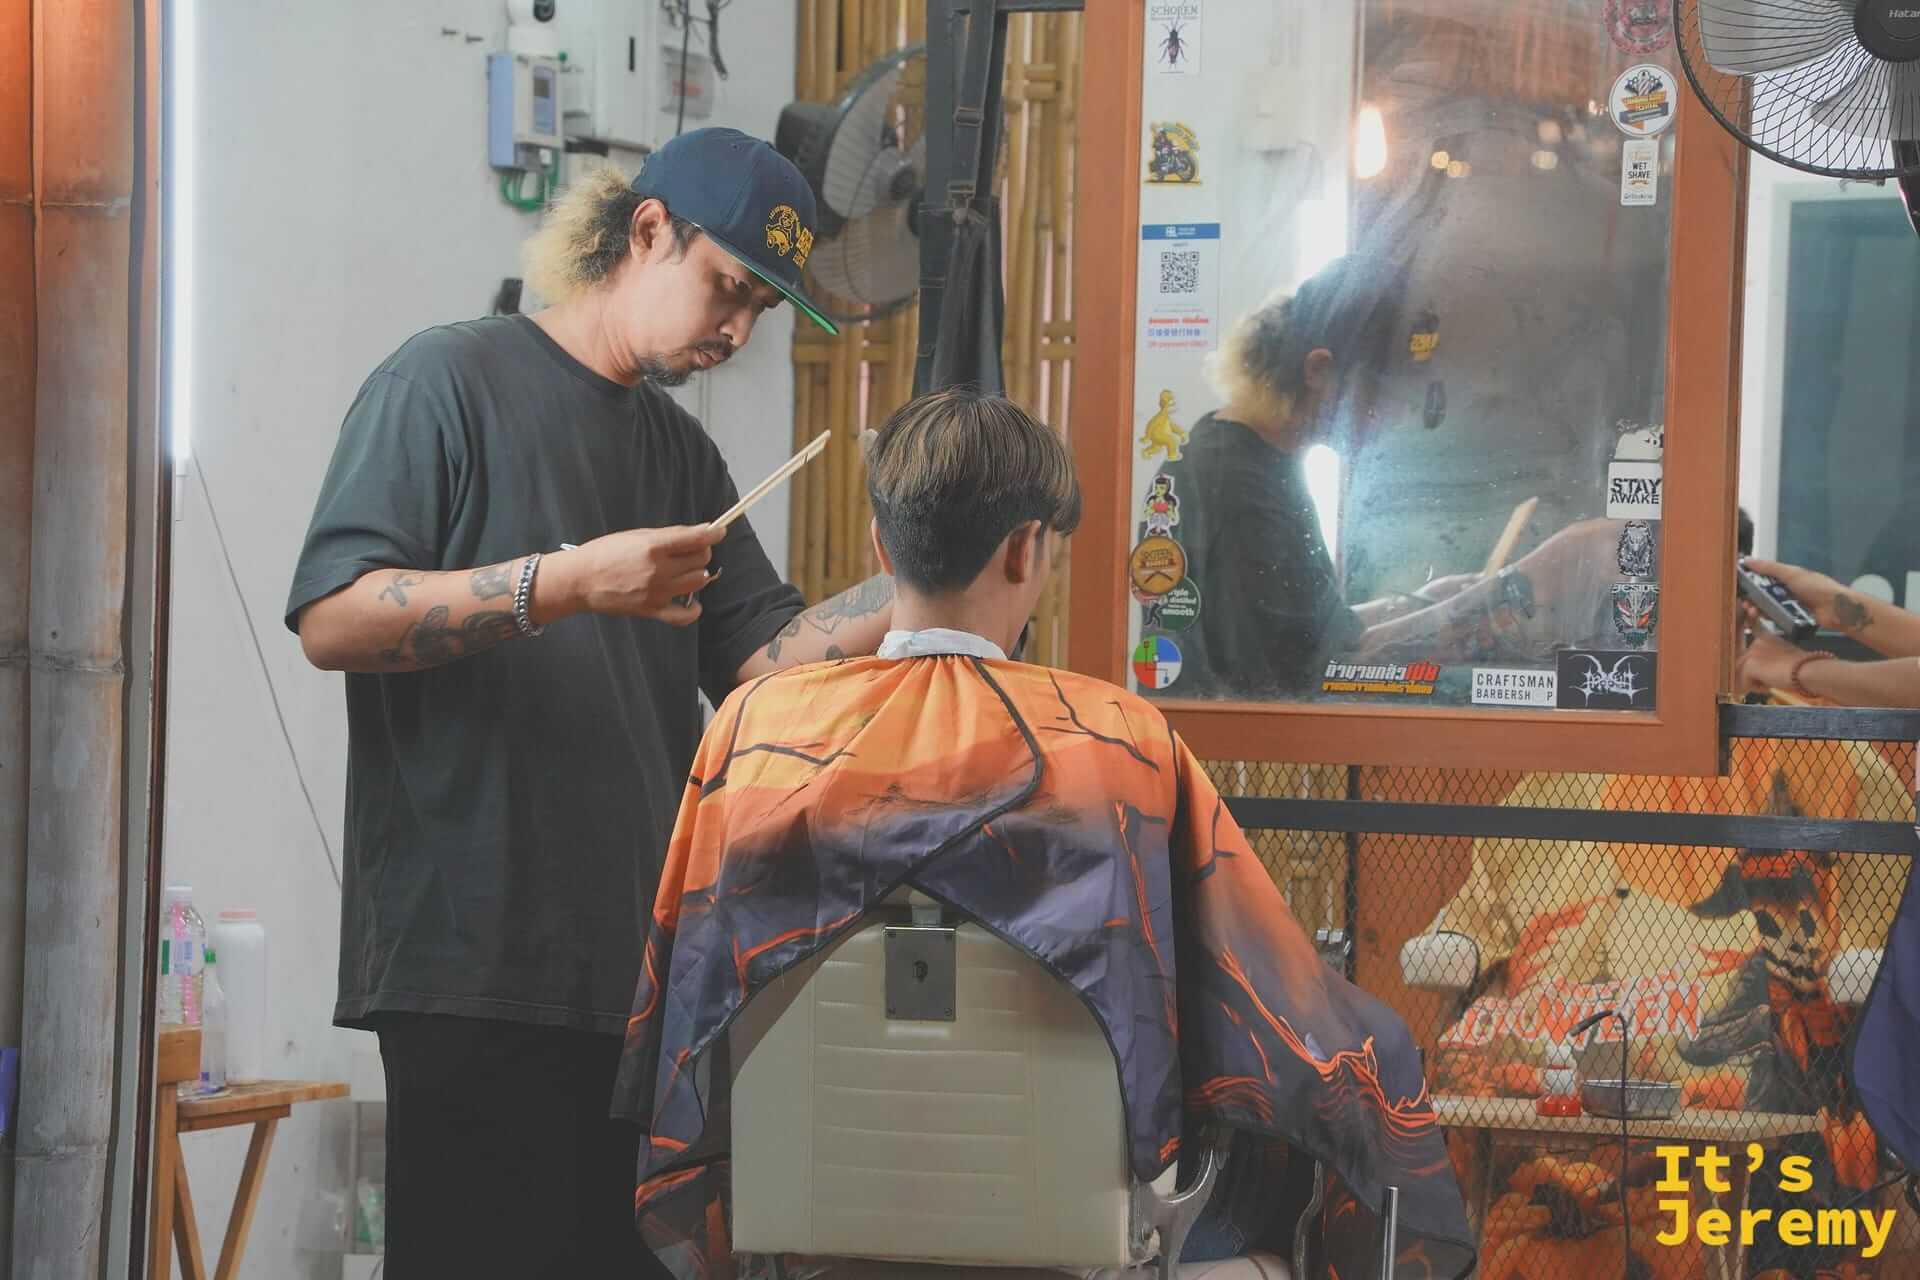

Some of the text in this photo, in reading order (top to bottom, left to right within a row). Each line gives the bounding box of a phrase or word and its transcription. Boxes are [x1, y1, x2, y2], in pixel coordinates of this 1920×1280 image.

[1611, 478, 1662, 494] STAY
[1610, 494, 1659, 505] AWAKE
[1162, 607, 1195, 617] smooth
[1476, 672, 1554, 689] CRAFTSMAN
